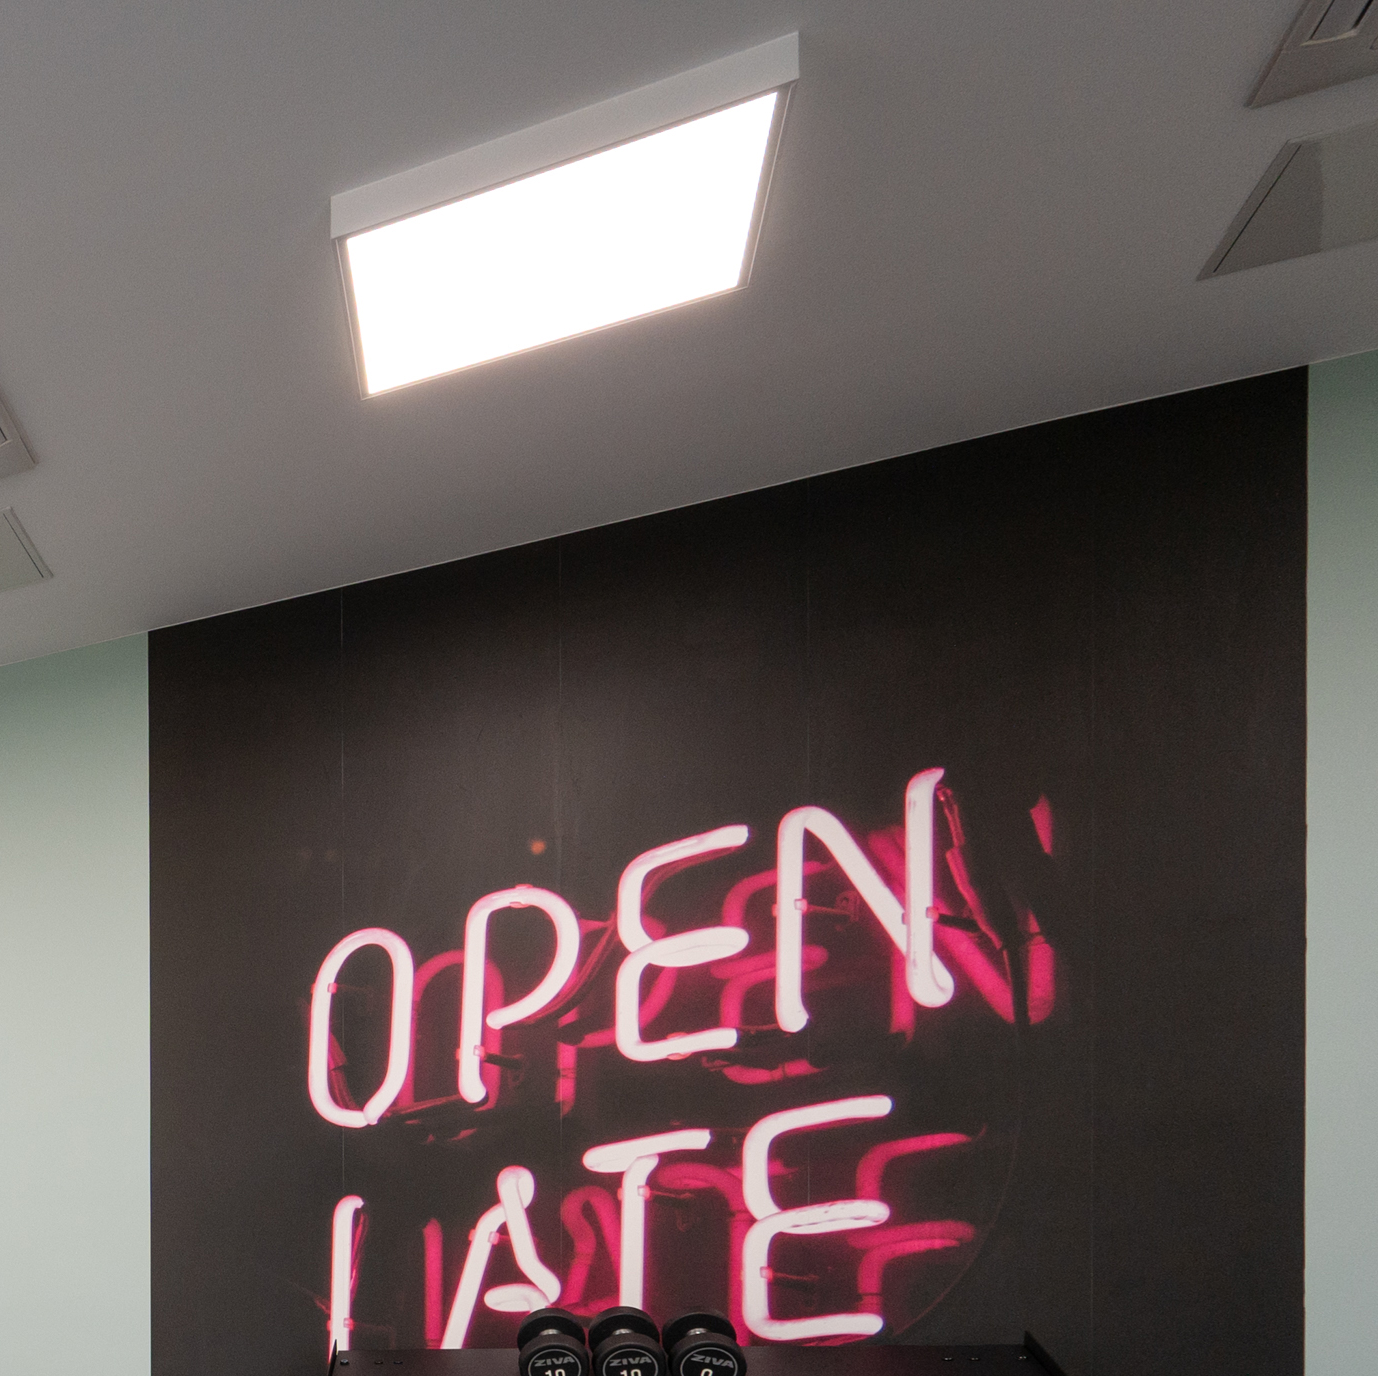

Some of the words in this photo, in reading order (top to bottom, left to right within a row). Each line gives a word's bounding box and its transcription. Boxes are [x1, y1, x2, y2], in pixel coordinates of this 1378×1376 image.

[306, 766, 956, 1128] OPEN
[534, 1355, 576, 1367] ZIVA
[608, 1355, 653, 1367] ZIVA
[690, 1353, 735, 1369] ZIVA
